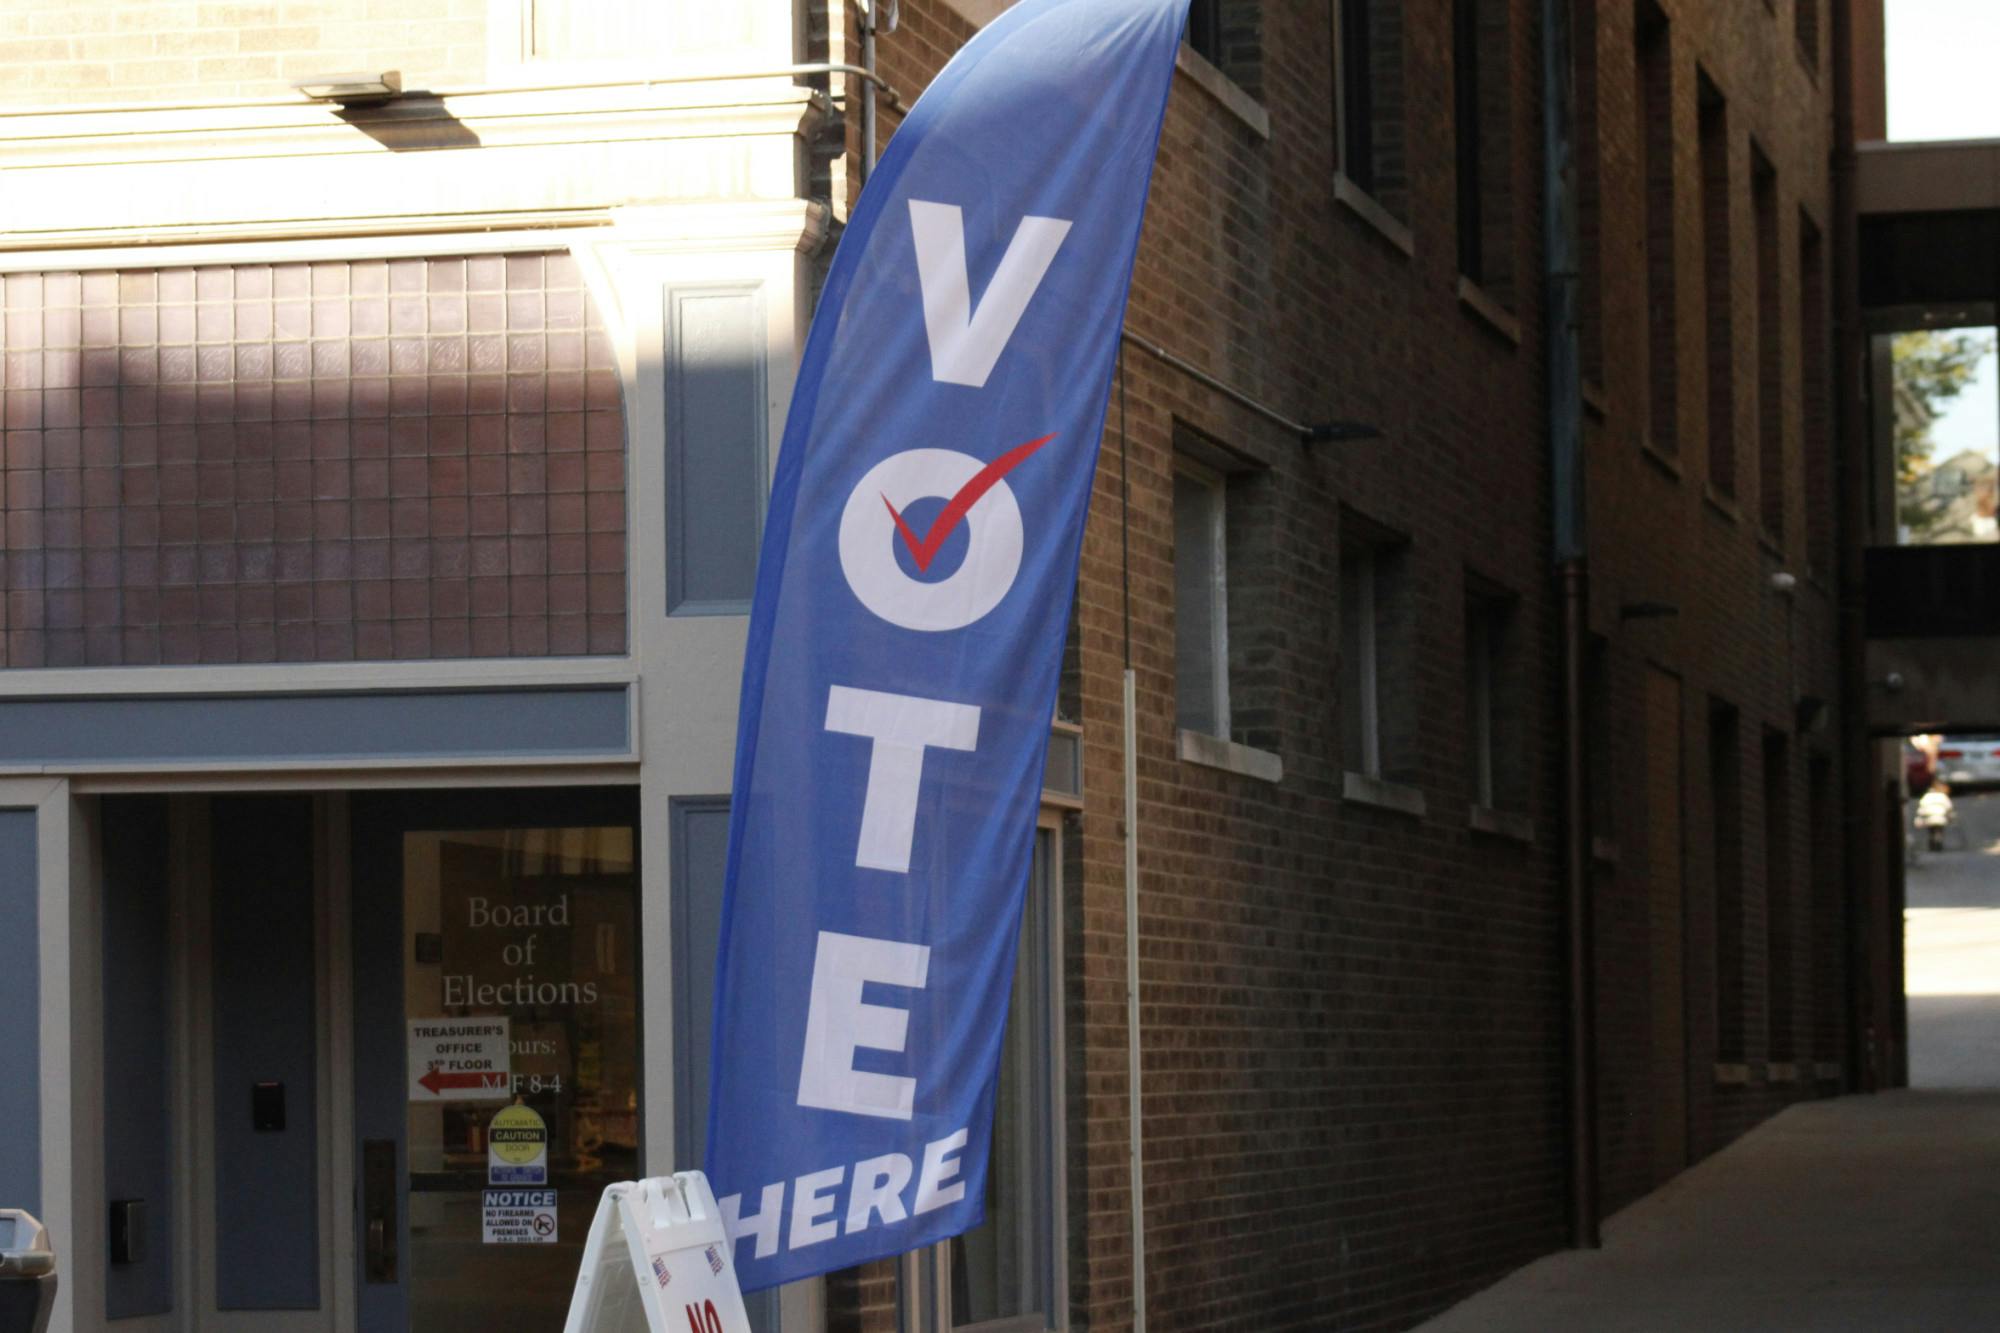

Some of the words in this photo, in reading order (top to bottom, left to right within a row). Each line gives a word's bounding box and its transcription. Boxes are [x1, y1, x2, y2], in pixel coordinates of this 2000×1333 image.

[797, 199, 1073, 1121] VOTE
[467, 894, 571, 928] Board
[502, 933, 538, 967] of
[442, 974, 599, 1007] Elections
[413, 1024, 504, 1038] TREASURER'S
[435, 1043, 483, 1054] OFFICE
[508, 1039, 557, 1055] ours:
[448, 1059, 493, 1070] FLOOR
[530, 1073, 563, 1094] 8-4
[495, 1131, 540, 1141] CAUTION
[485, 1192, 555, 1206] NOTICE
[716, 1127, 969, 1260] HERE
[485, 1209, 497, 1217] NO
[498, 1209, 535, 1217] FIREARMS
[486, 1218, 520, 1226] ALLOWED
[521, 1218, 533, 1226] ON
[492, 1228, 529, 1236] PREMISES
[685, 1298, 724, 1333] NO
